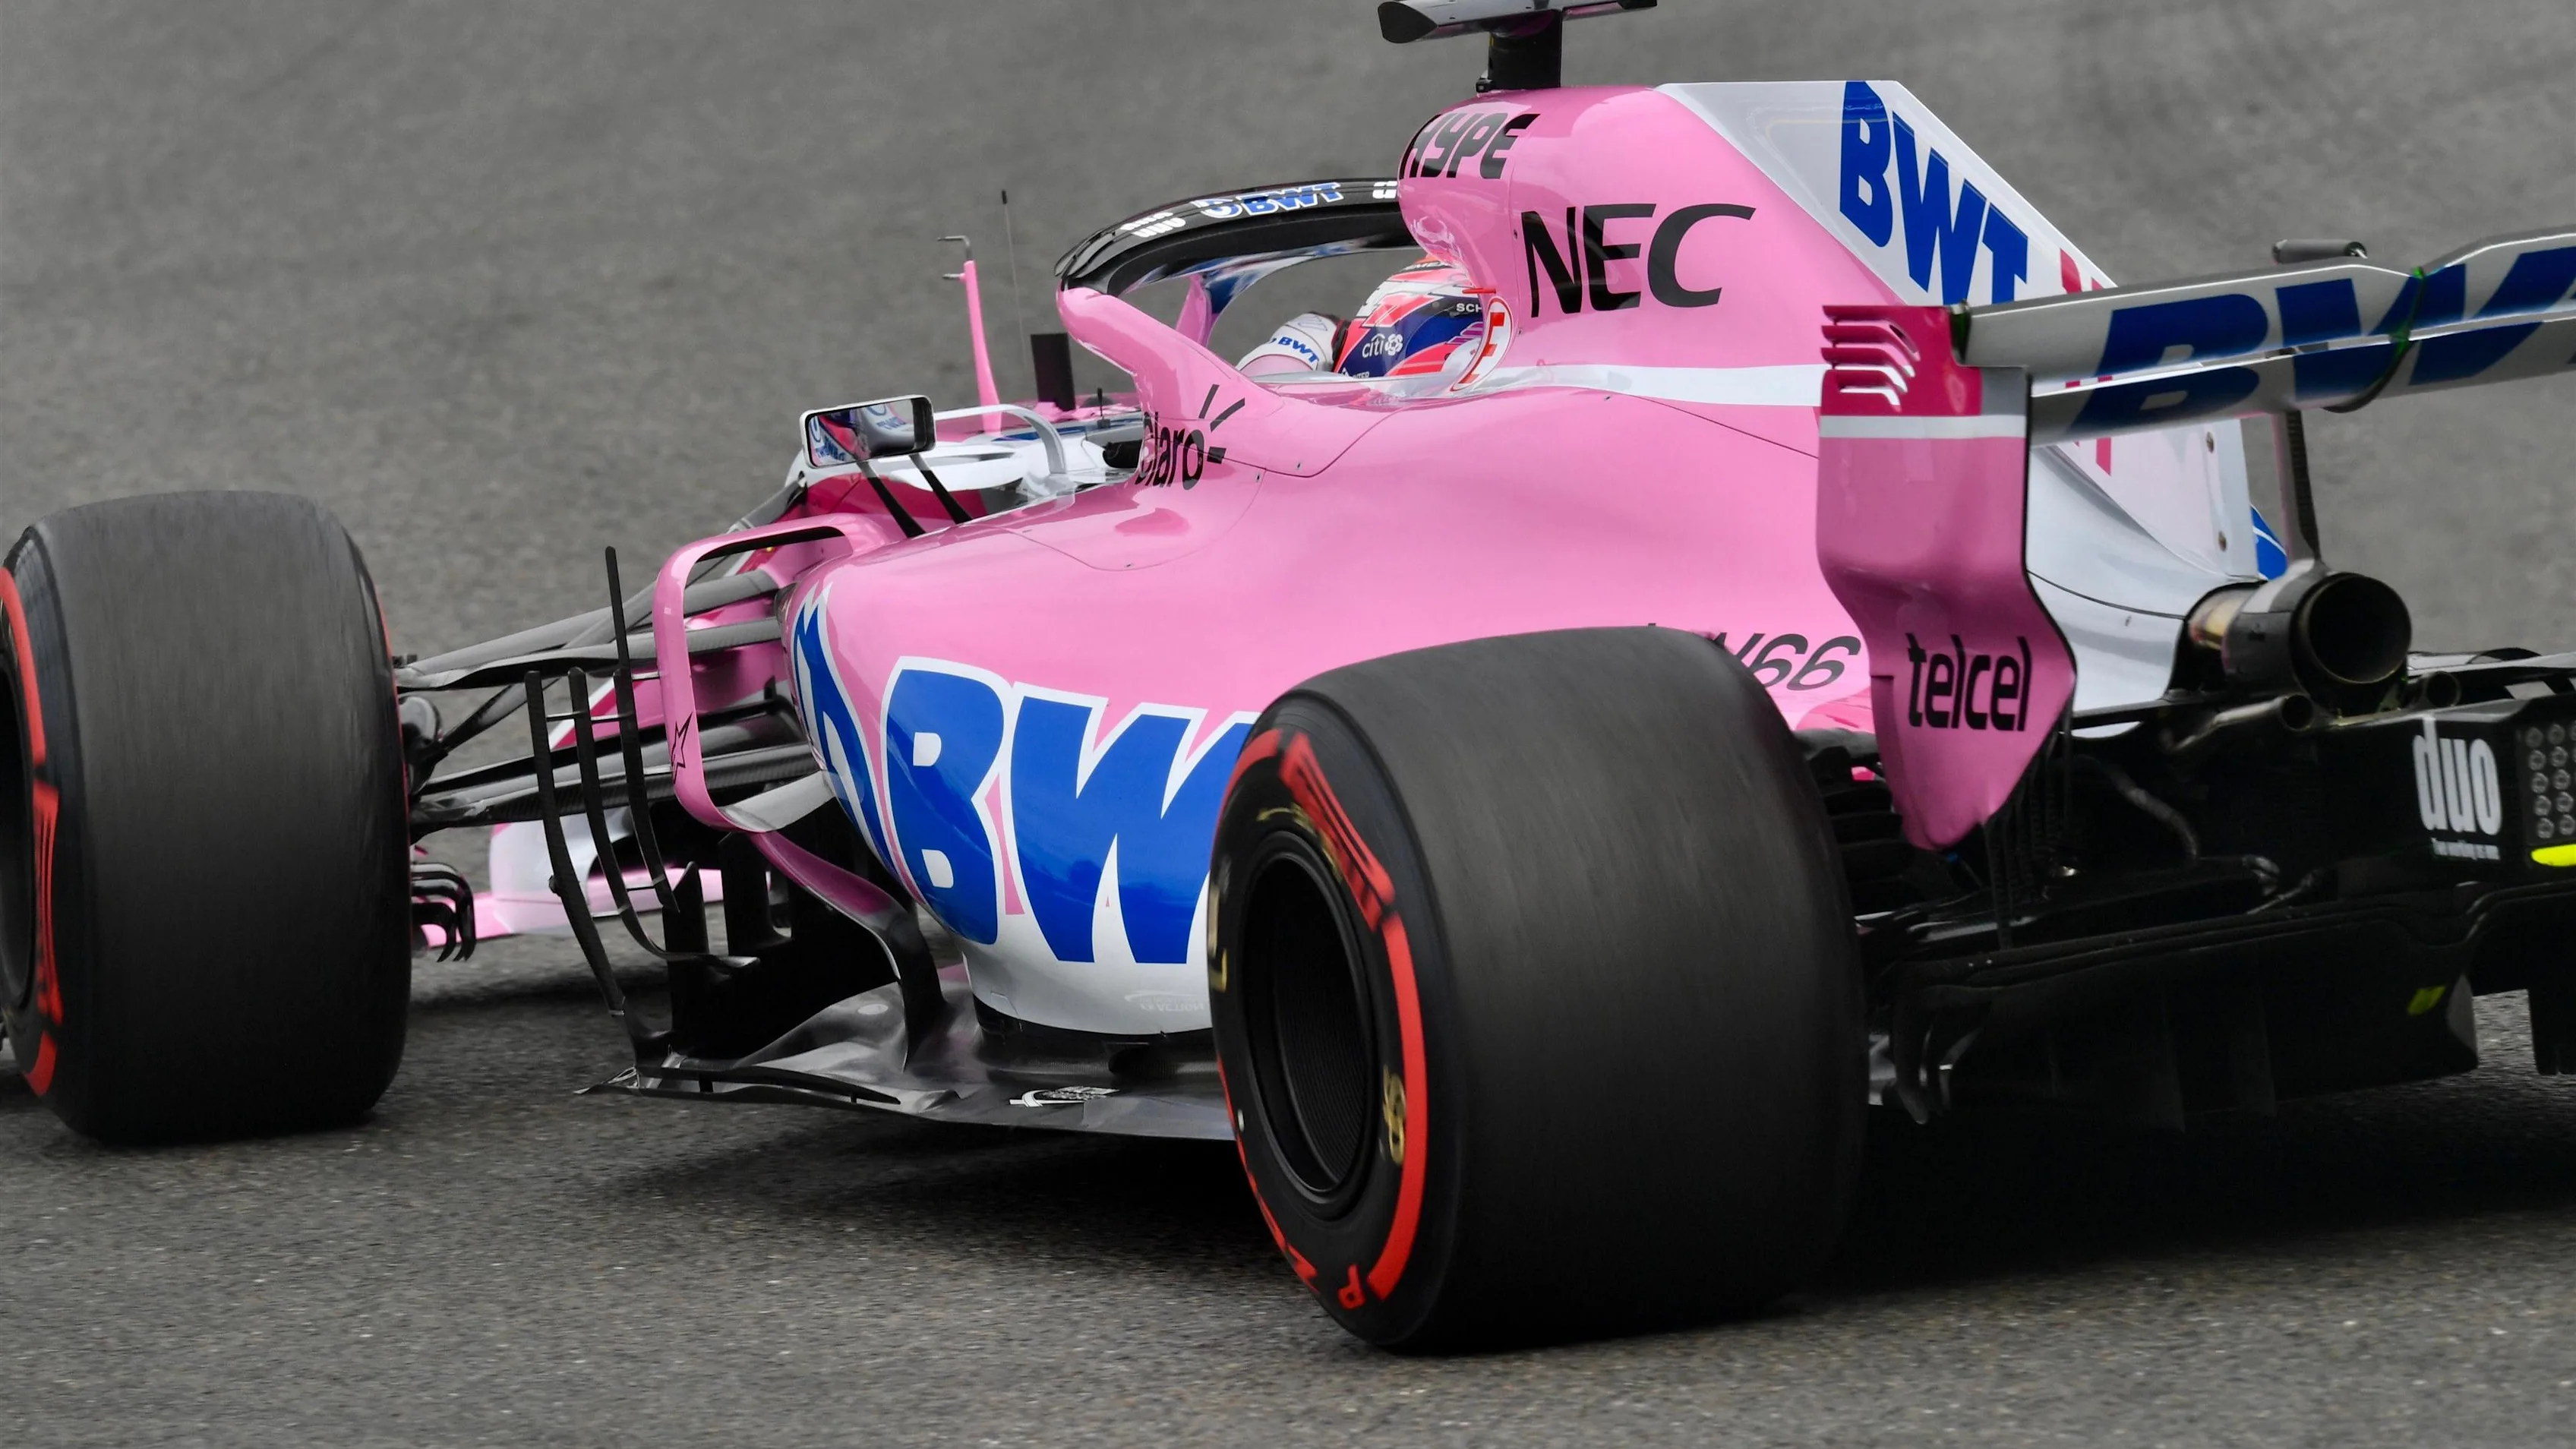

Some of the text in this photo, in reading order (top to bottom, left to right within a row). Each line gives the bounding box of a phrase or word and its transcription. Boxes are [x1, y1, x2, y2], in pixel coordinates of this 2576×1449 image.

[1399, 113, 1541, 179] HYPE
[1839, 80, 2028, 305] BWT
[1236, 182, 1344, 216] BWT
[1520, 203, 1757, 318] NEC
[1277, 336, 1320, 364] BWT
[1362, 333, 1387, 358] citi
[2069, 246, 2576, 431] BW
[1736, 632, 1861, 691] 66
[1905, 632, 2032, 731] telcel
[881, 655, 1261, 964] BW
[2412, 715, 2502, 835] duo
